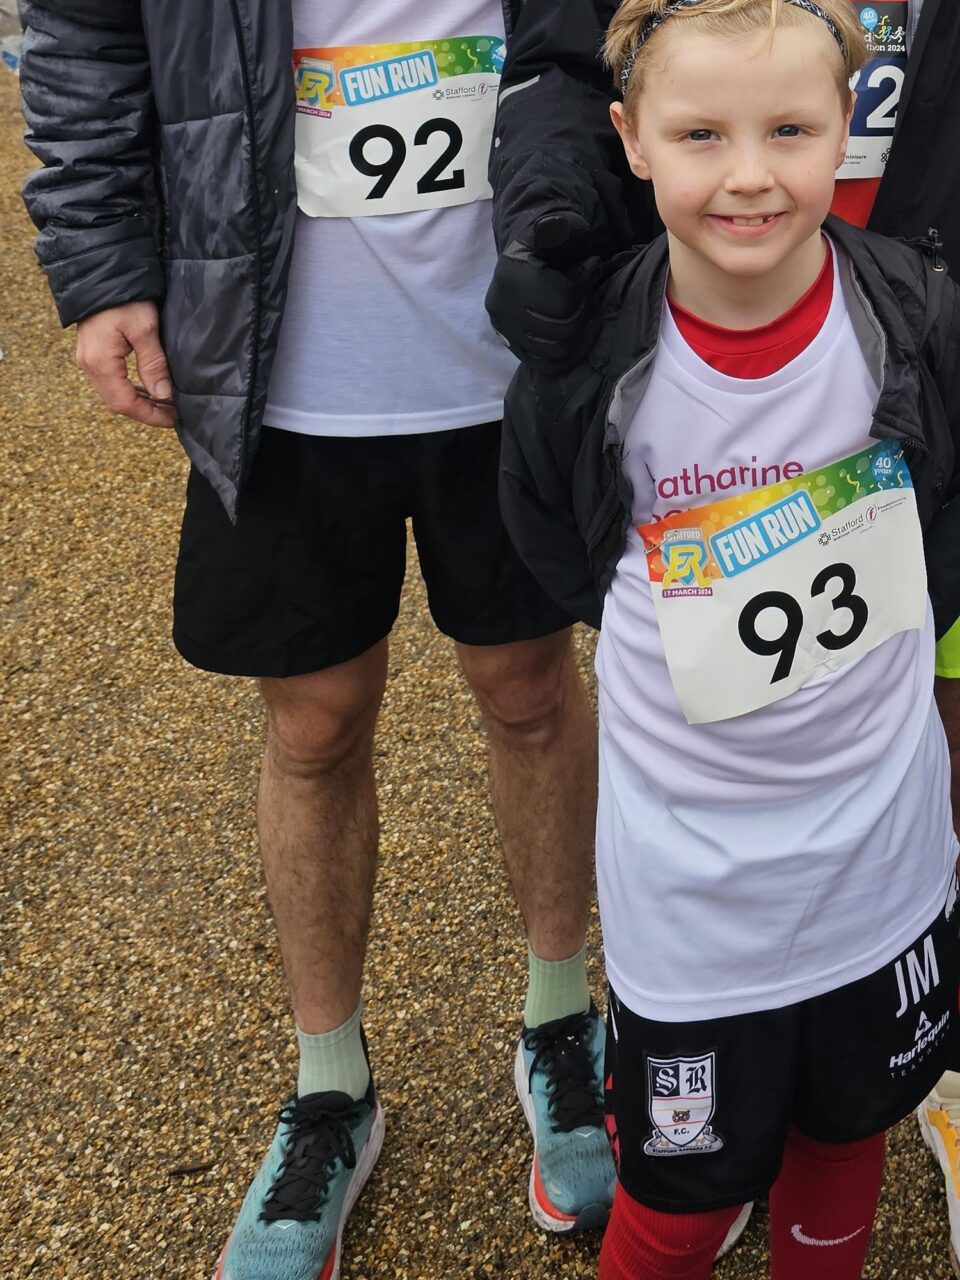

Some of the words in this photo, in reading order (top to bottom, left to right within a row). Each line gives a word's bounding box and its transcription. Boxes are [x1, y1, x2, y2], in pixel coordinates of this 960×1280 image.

[344, 66, 388, 102] FUN
[388, 54, 434, 91] RUN
[445, 86, 476, 96] Stafford
[349, 117, 466, 201] 92
[657, 456, 803, 499] atharine
[875, 457, 891, 468] 40
[716, 522, 769, 572] FUN
[761, 495, 816, 549] RUN
[831, 514, 864, 537] Stafford
[738, 562, 868, 685] 93
[895, 933, 940, 1018] JM
[889, 1010, 949, 1068] Harlequin
[655, 1068, 678, 1095] S
[685, 1064, 707, 1095] R
[673, 1127, 690, 1136] F.C.
